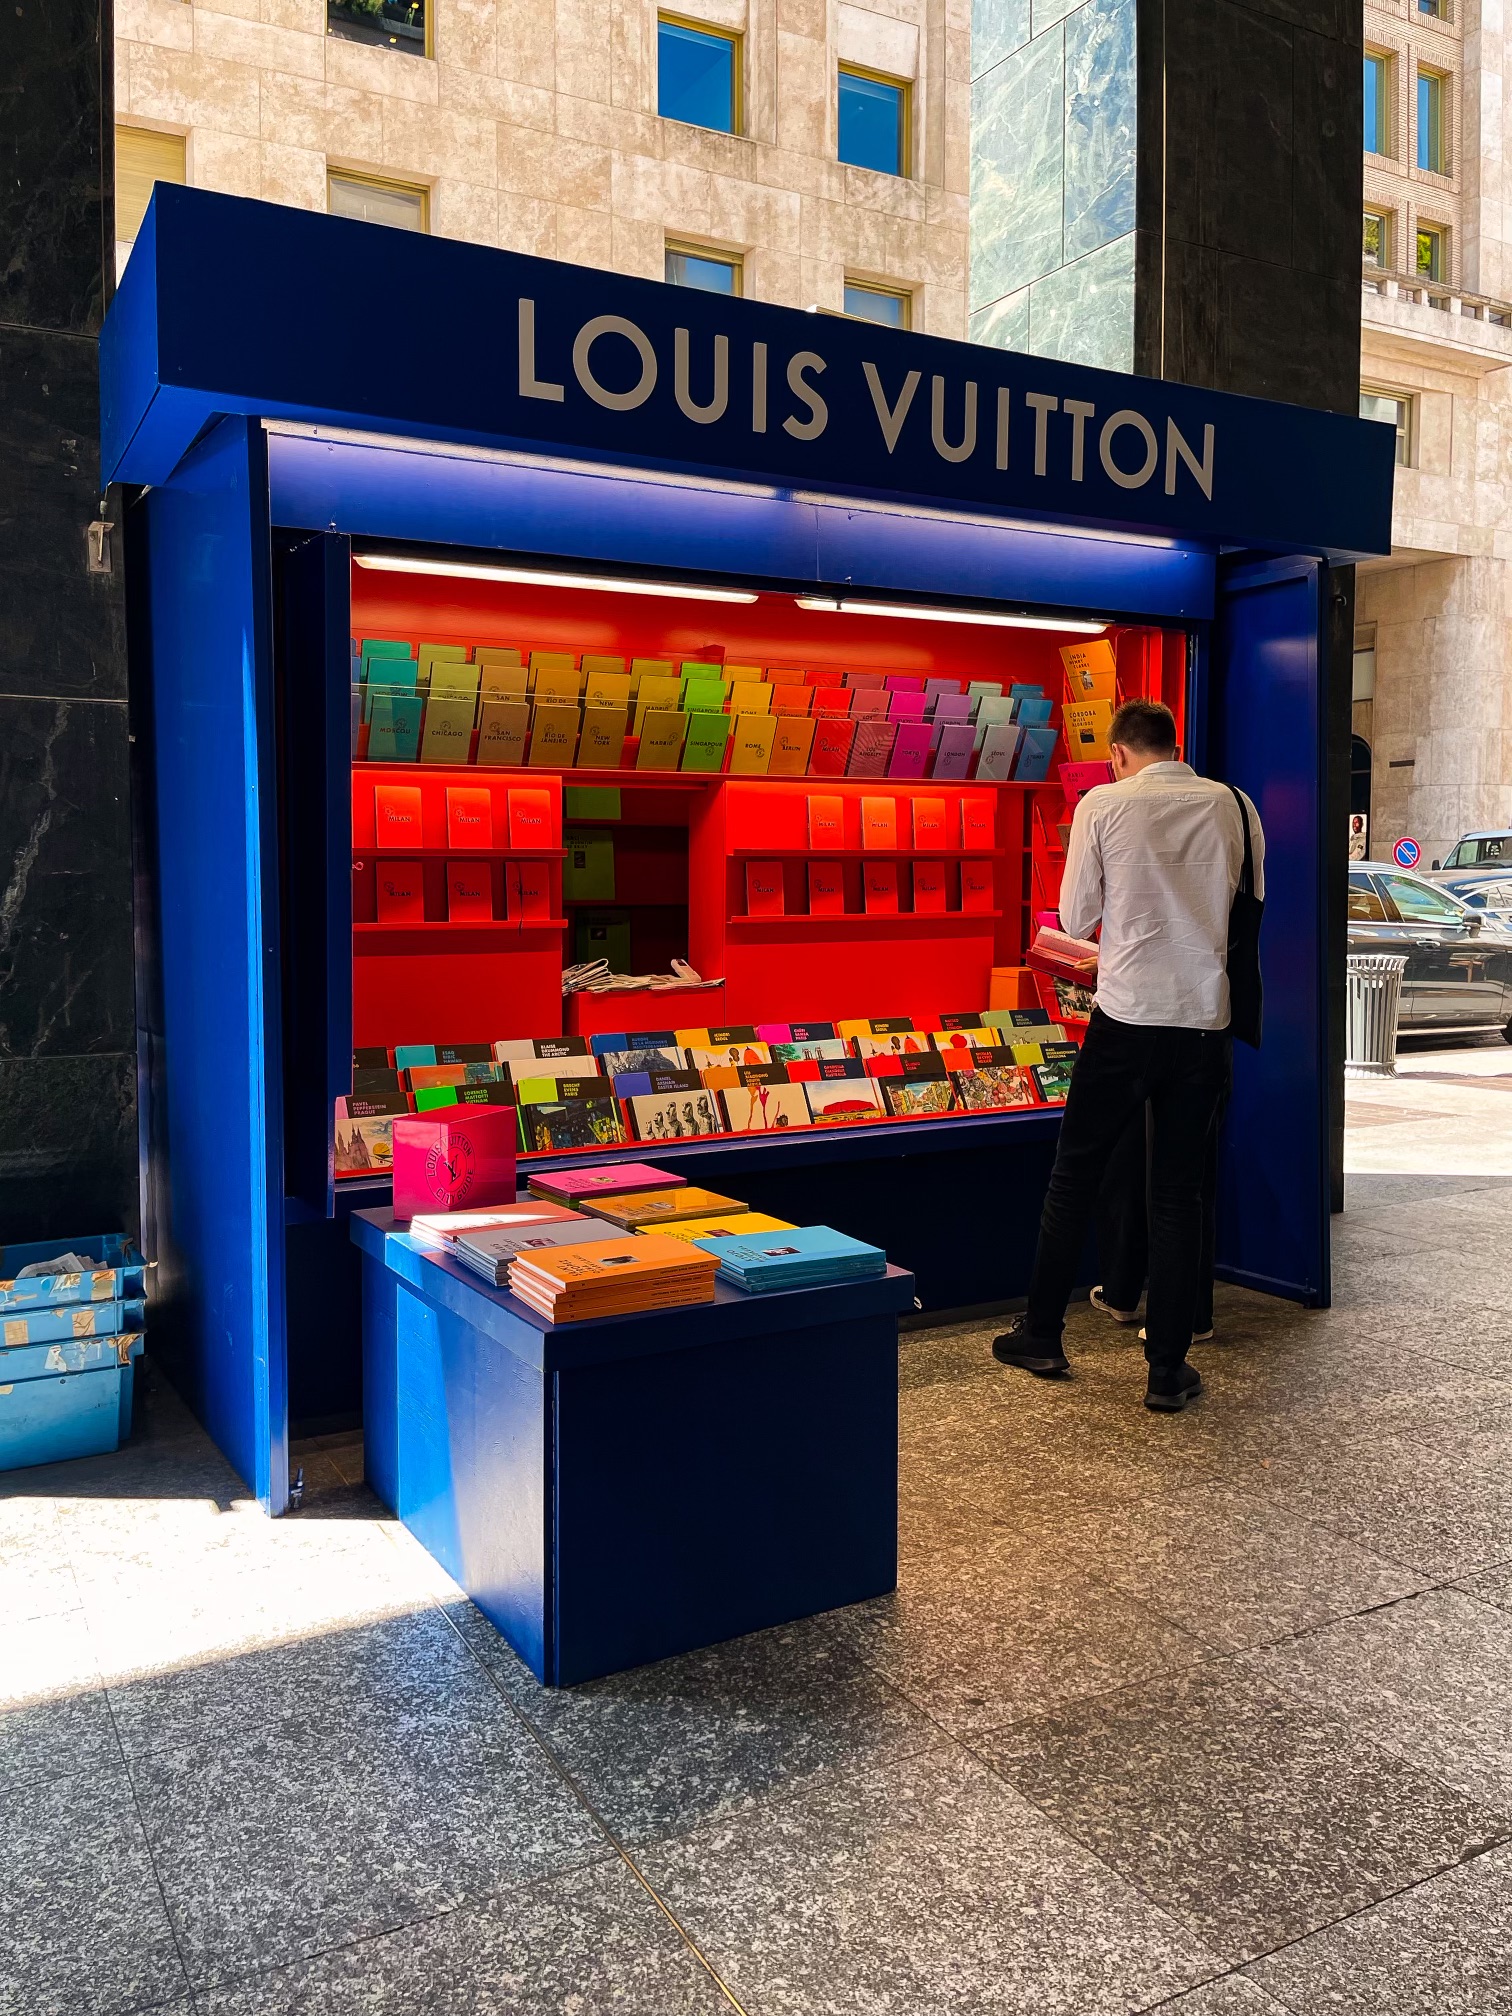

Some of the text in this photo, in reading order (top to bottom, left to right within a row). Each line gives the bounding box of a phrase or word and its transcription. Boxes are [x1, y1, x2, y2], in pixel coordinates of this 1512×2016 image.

[518, 298, 1215, 501] LOUIS VUITTON
[426, 1135, 472, 1177] LOUIS VUITTON
[436, 1168, 474, 1204] CITY GUIDE
